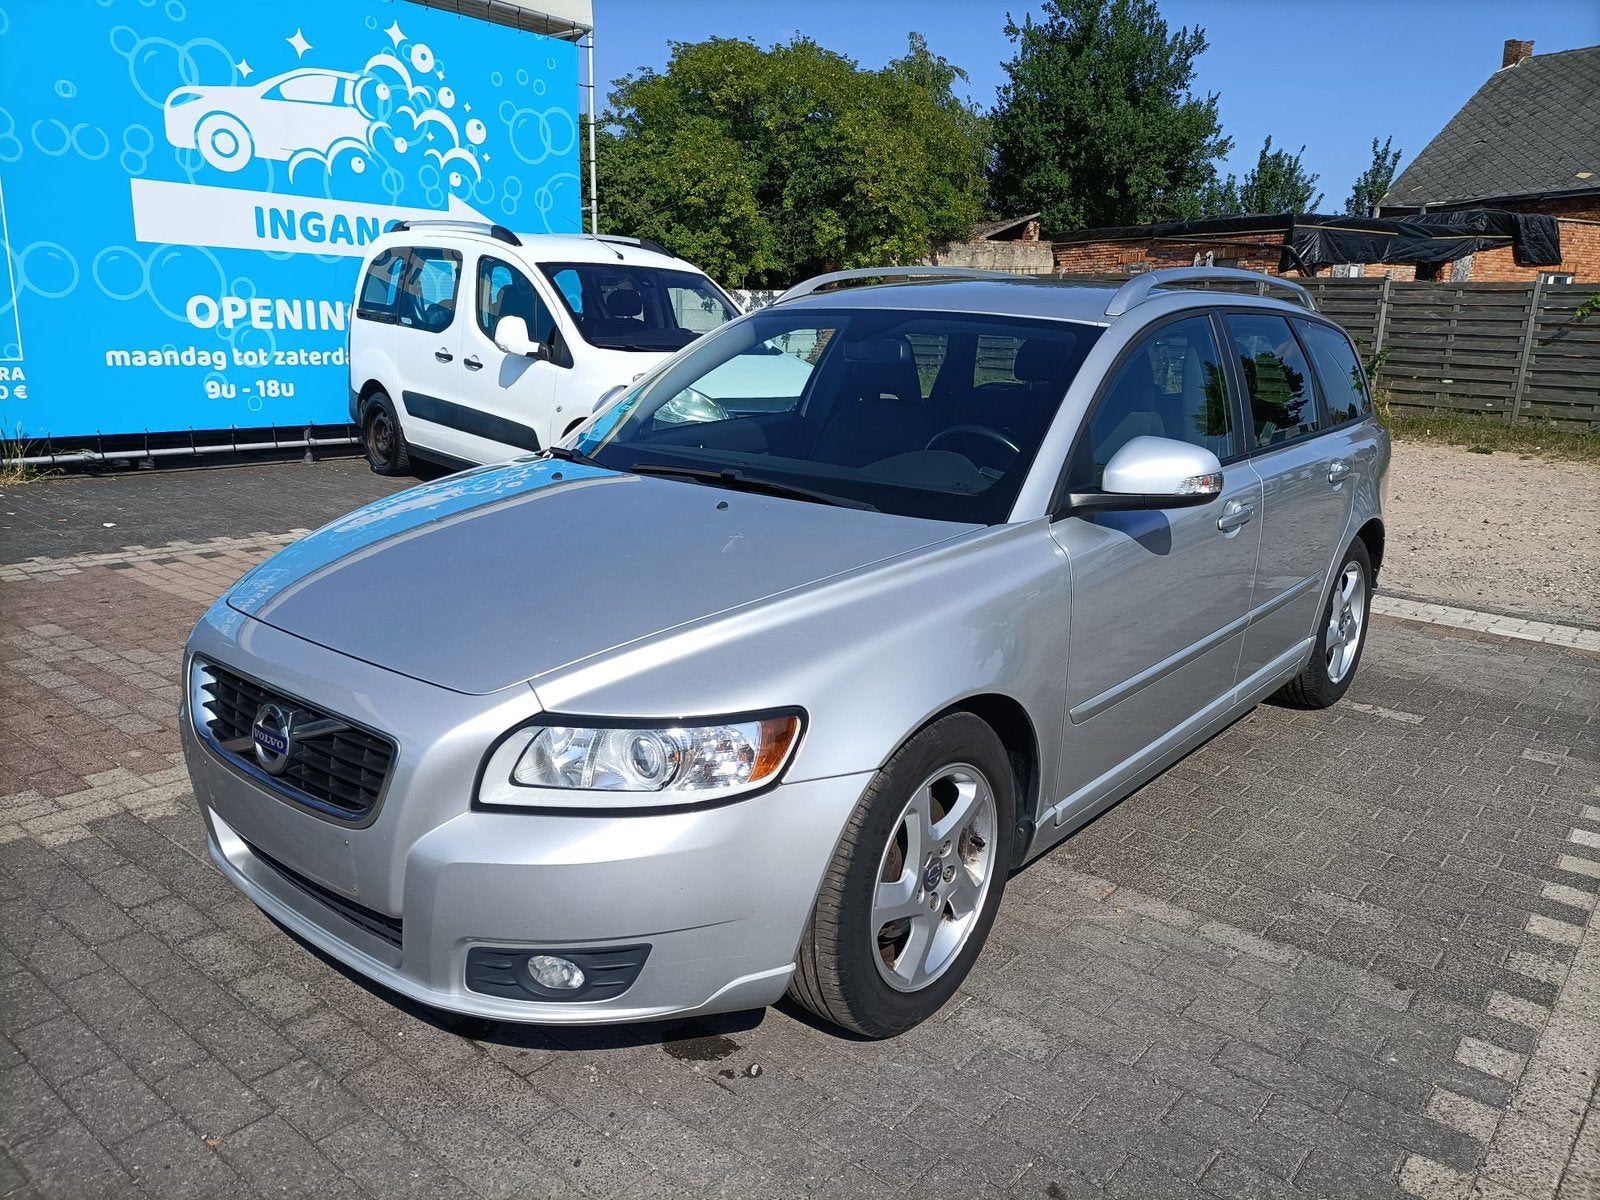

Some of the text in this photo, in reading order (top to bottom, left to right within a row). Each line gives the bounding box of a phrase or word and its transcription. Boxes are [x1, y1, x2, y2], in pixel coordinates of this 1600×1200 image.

[186, 295, 350, 331] OPENIN
[105, 346, 227, 371] maandag
[233, 347, 269, 366] tot
[205, 380, 236, 399] 9u
[255, 379, 294, 397] 18u
[254, 727, 284, 749] VOLVO
